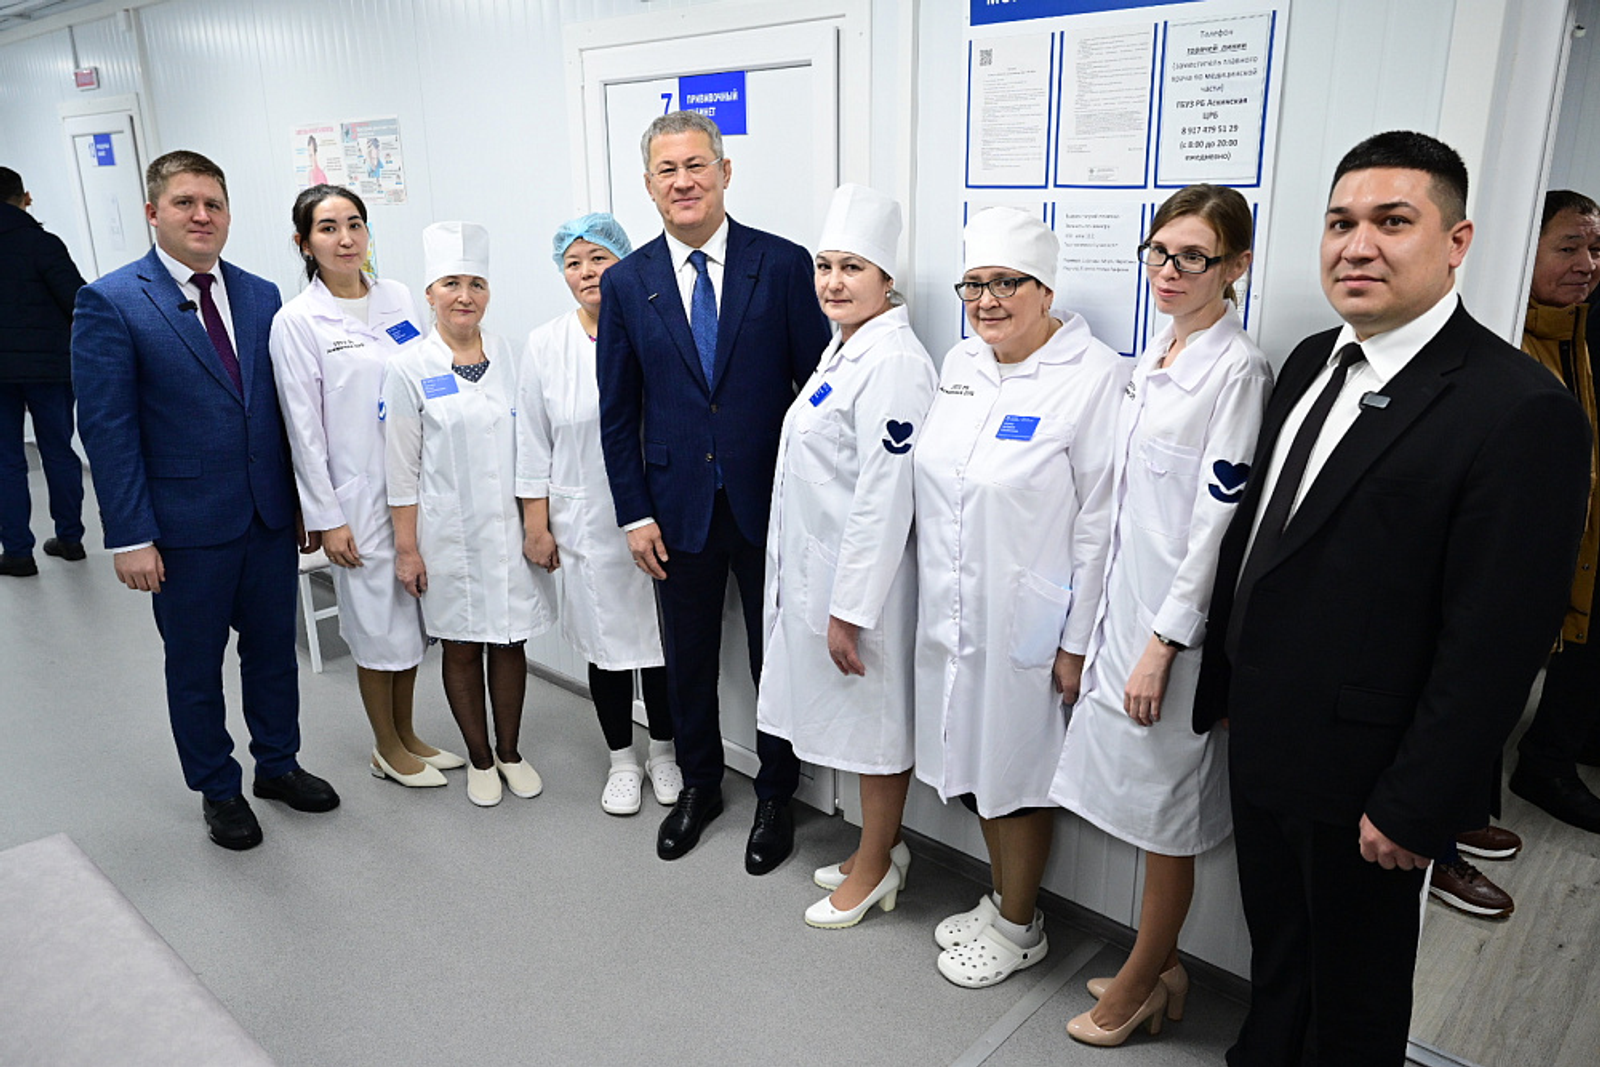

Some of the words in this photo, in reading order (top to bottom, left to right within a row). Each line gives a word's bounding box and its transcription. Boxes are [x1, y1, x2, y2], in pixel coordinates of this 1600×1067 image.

[661, 93, 673, 115] 7
[686, 88, 738, 104] ПРИВИВОЧНЫЙ
[1217, 139, 1238, 147] 20:00
